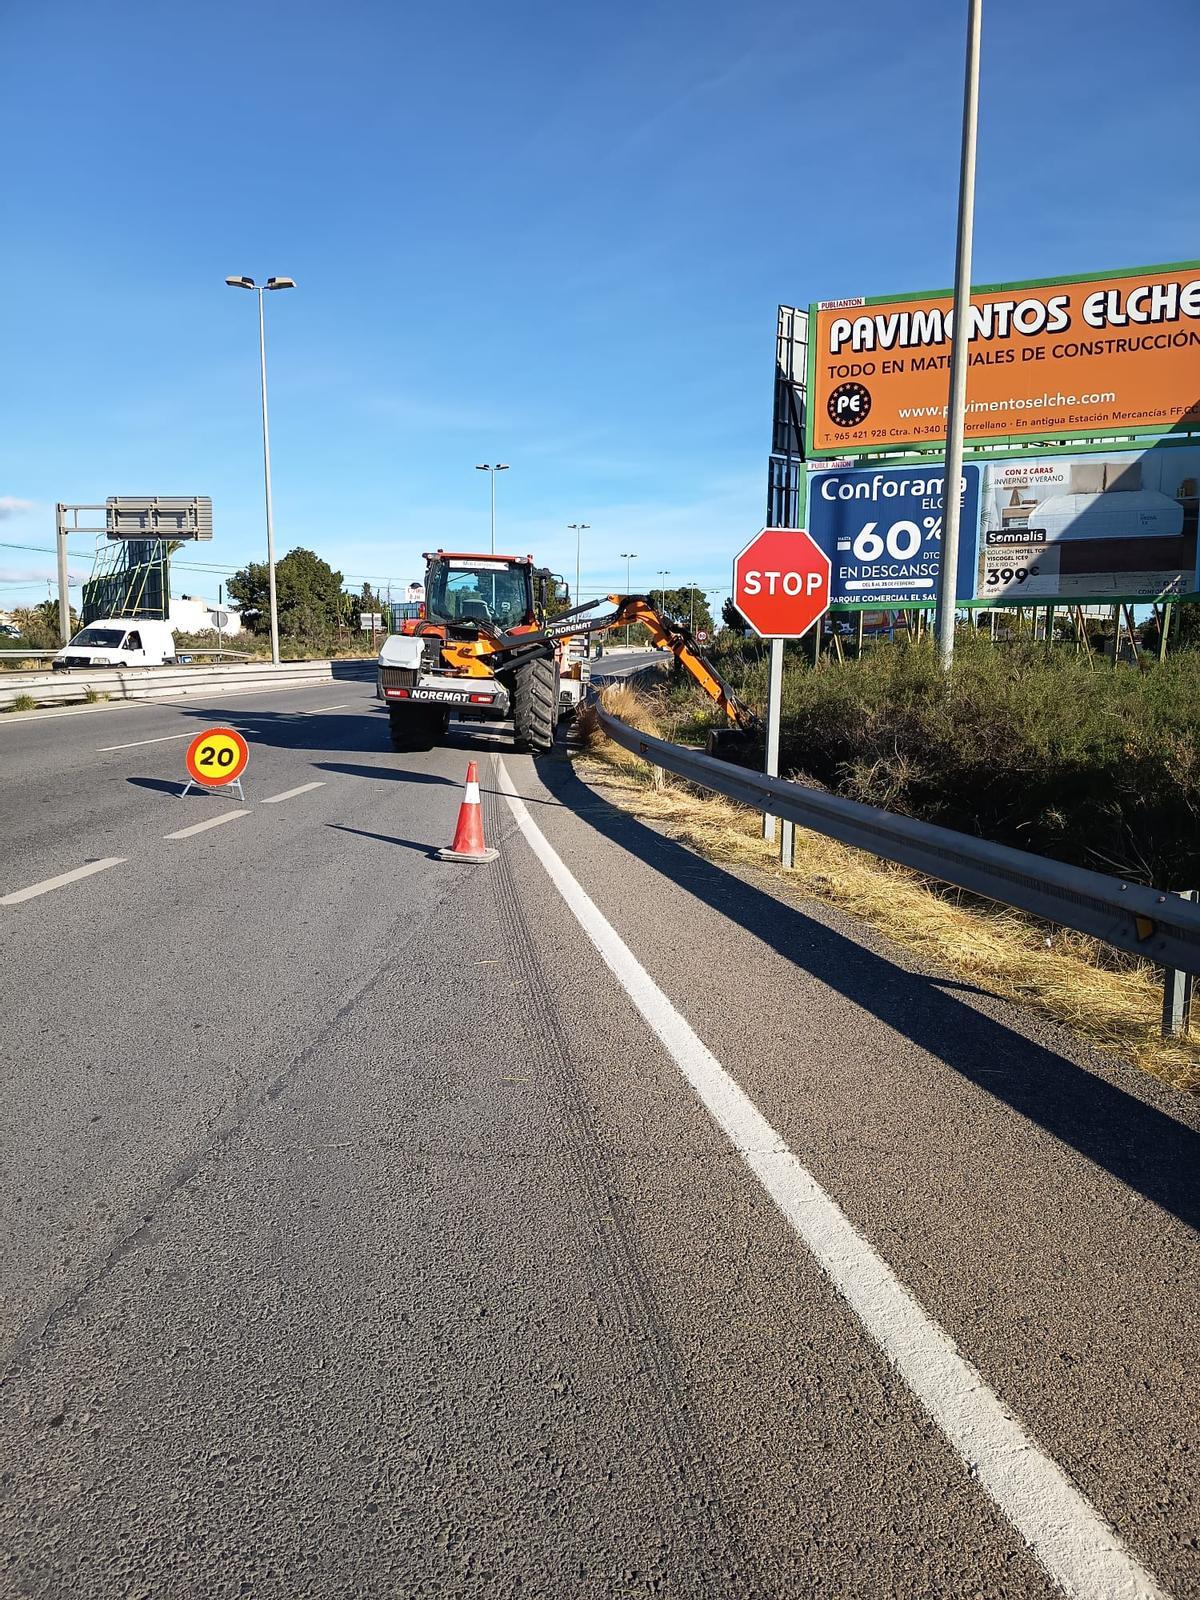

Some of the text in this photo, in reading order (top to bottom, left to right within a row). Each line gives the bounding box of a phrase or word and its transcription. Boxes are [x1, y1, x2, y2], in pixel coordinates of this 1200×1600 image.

[1082, 279, 1200, 329] ELCHE
[828, 329, 1200, 379] TODO EN MATIALES DE CONSTRUCCIÓN
[837, 394, 861, 414] PE
[898, 391, 1116, 419] www.pvimentoselche.com
[824, 433, 832, 442] T.
[834, 431, 850, 441] 965
[852, 430, 867, 439] 421
[871, 429, 887, 438] 928
[889, 427, 910, 437] Ctra.
[913, 425, 940, 435] N-340
[963, 420, 1007, 431] Torrellano
[1016, 418, 1028, 427] En
[1030, 416, 1066, 426] antigua
[1068, 413, 1109, 423] Estación
[1112, 408, 1167, 420] Mercancías
[1005, 468, 1022, 476] CON
[994, 477, 1027, 485] INVIERNO
[1035, 475, 1064, 483] VERANO
[922, 496, 965, 509] ELCE
[989, 530, 1044, 543] Somnalis
[839, 566, 858, 579] EN
[743, 570, 823, 596] STOP
[830, 595, 861, 604] PARQUE
[861, 594, 909, 602] COMERCIAL
[911, 593, 920, 601] EL
[554, 621, 592, 635] NOREMAT
[411, 689, 470, 703] NOREMAT
[200, 746, 234, 767] 20
